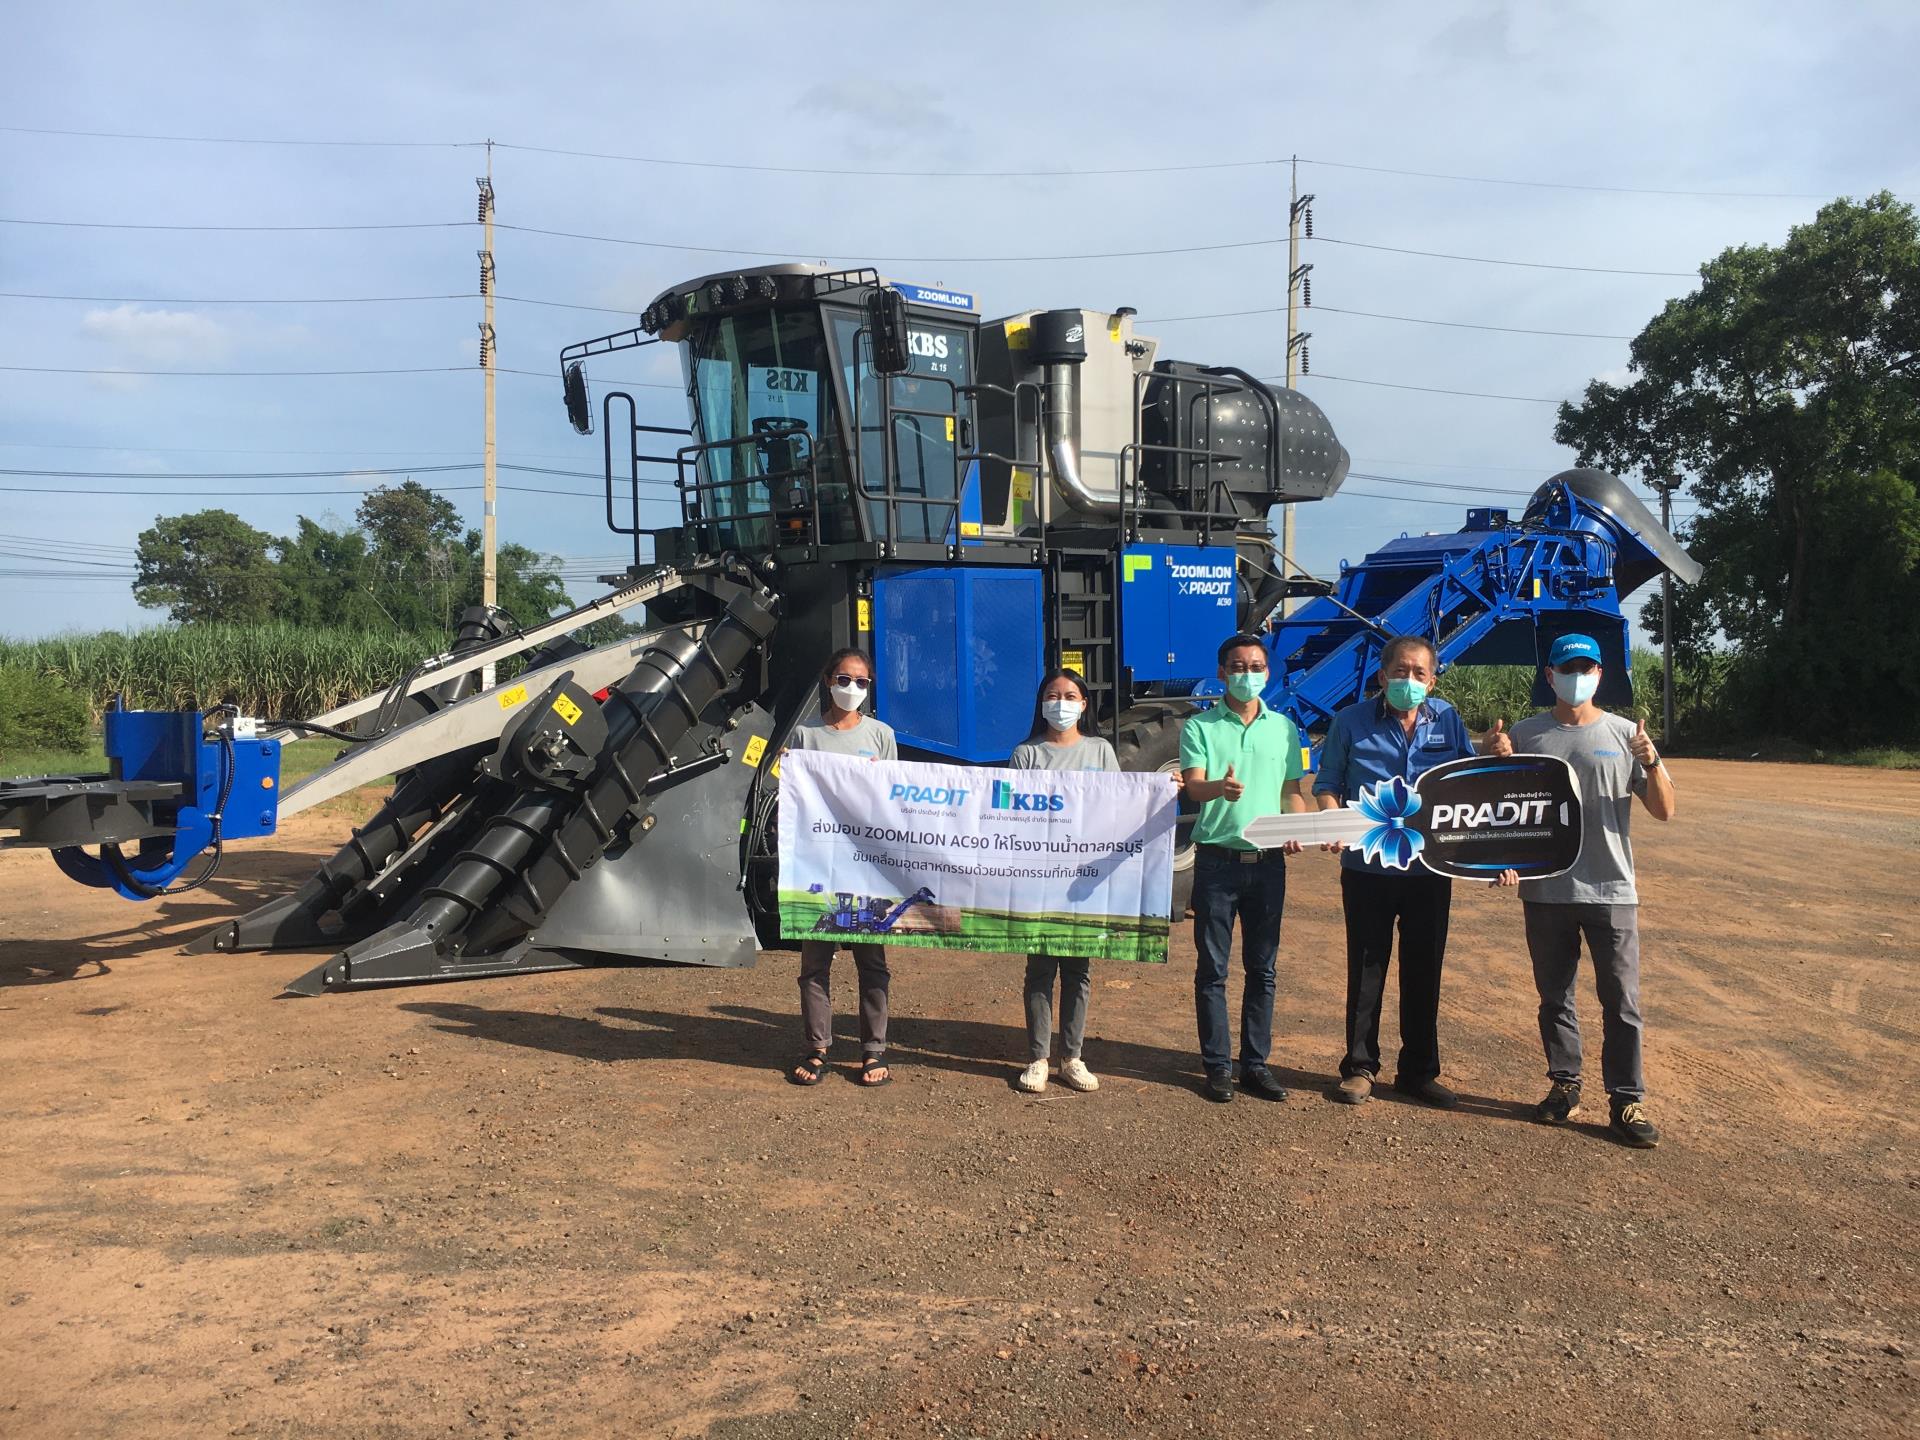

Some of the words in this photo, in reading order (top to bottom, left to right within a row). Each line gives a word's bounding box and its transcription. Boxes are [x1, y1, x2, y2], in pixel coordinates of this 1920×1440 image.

[917, 290, 969, 306] ZOOMLION
[907, 331, 948, 359] KBS
[1171, 565, 1232, 579] ZOOMLION
[1178, 582, 1189, 595] X
[1189, 581, 1232, 595] PRADIT
[889, 783, 970, 807] PRADIT
[1012, 791, 1064, 812] KBS
[1431, 800, 1552, 830] PRADIT
[812, 818, 861, 837] ส่งมอบ
[864, 826, 946, 846] ZOOMLION
[950, 835, 990, 849] AC90
[993, 833, 1144, 857] ให้โรงงานน้ำตาลครบุรี
[853, 850, 1099, 879] ขับเคลื่อนอุตสาหกรรมด้วยนวัตกรรมที่ทันสมัย
